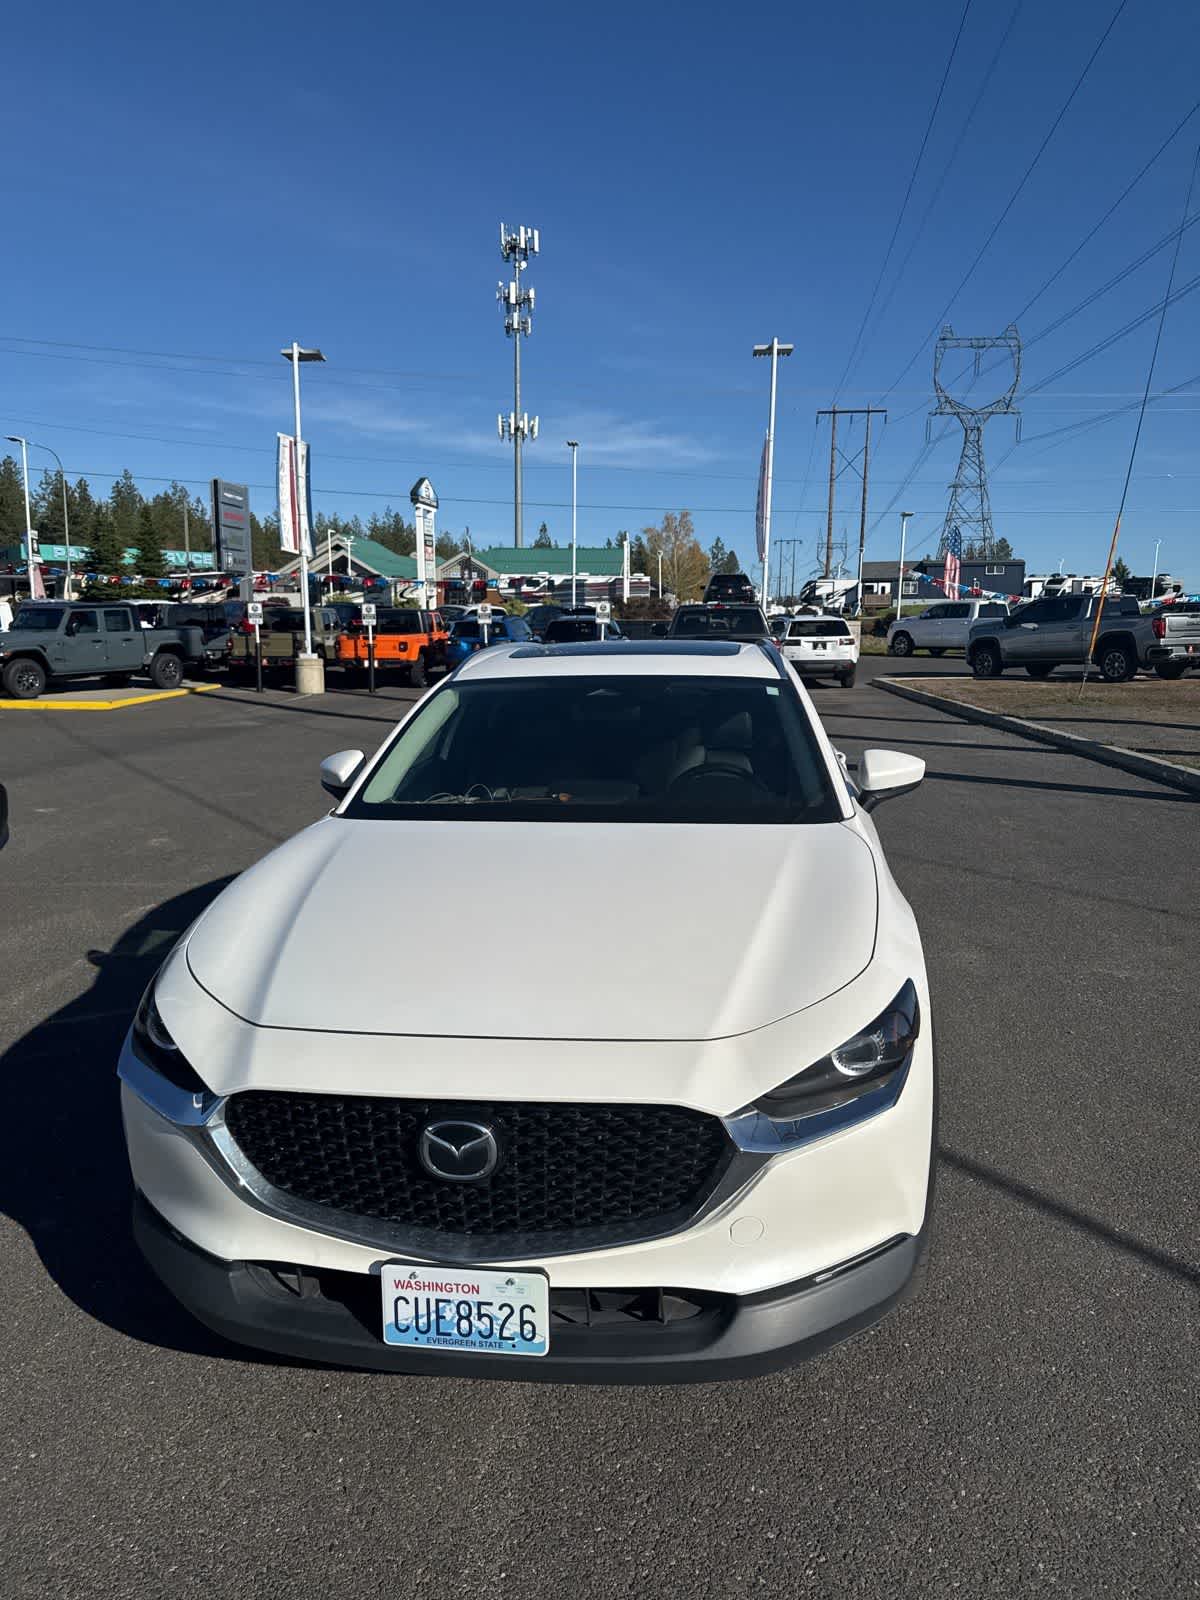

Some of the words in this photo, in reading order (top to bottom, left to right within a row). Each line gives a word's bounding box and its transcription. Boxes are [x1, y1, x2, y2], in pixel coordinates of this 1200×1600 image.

[394, 1279, 480, 1295] WASHINGTON
[394, 1295, 536, 1342] CUE8526
[426, 1336, 476, 1347] EVERGREEN
[479, 1340, 504, 1349] STATE
